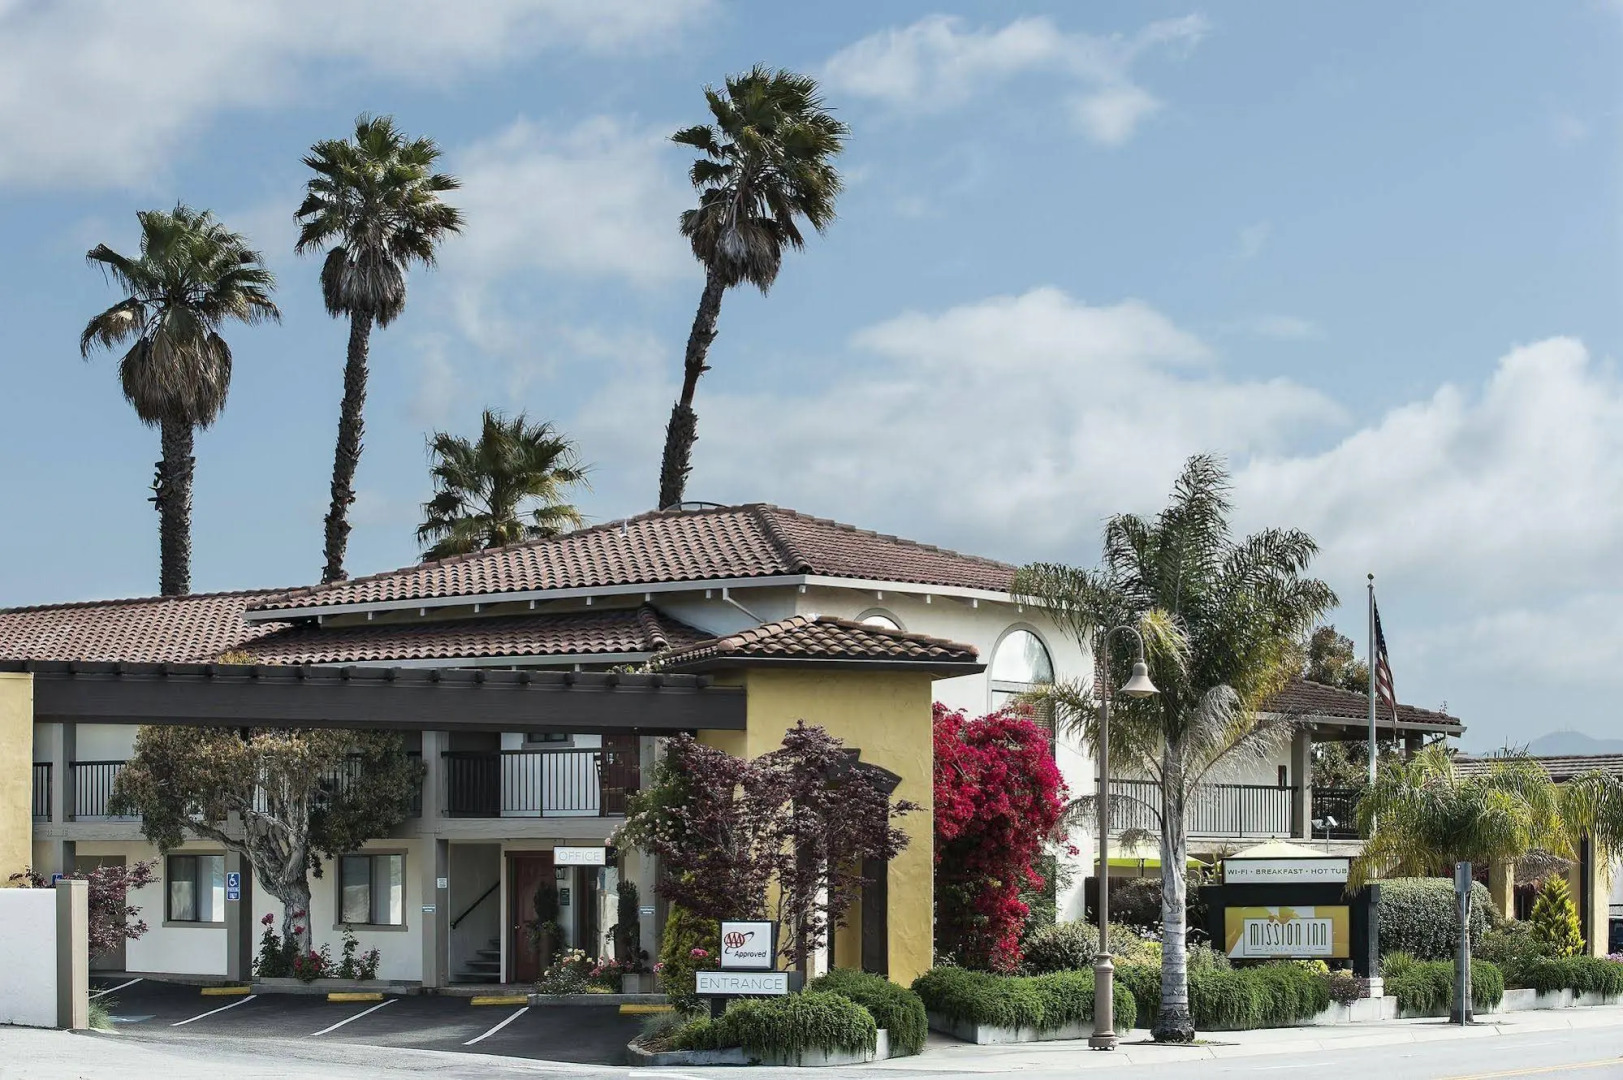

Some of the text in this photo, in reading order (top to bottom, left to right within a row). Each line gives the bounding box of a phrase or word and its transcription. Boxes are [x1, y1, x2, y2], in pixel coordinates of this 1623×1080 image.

[559, 851, 601, 861] OFFICE
[725, 932, 745, 948] AAA
[1250, 923, 1327, 946] MISSION INN
[734, 950, 767, 958] Approved
[700, 977, 783, 990] ENTRANCE
